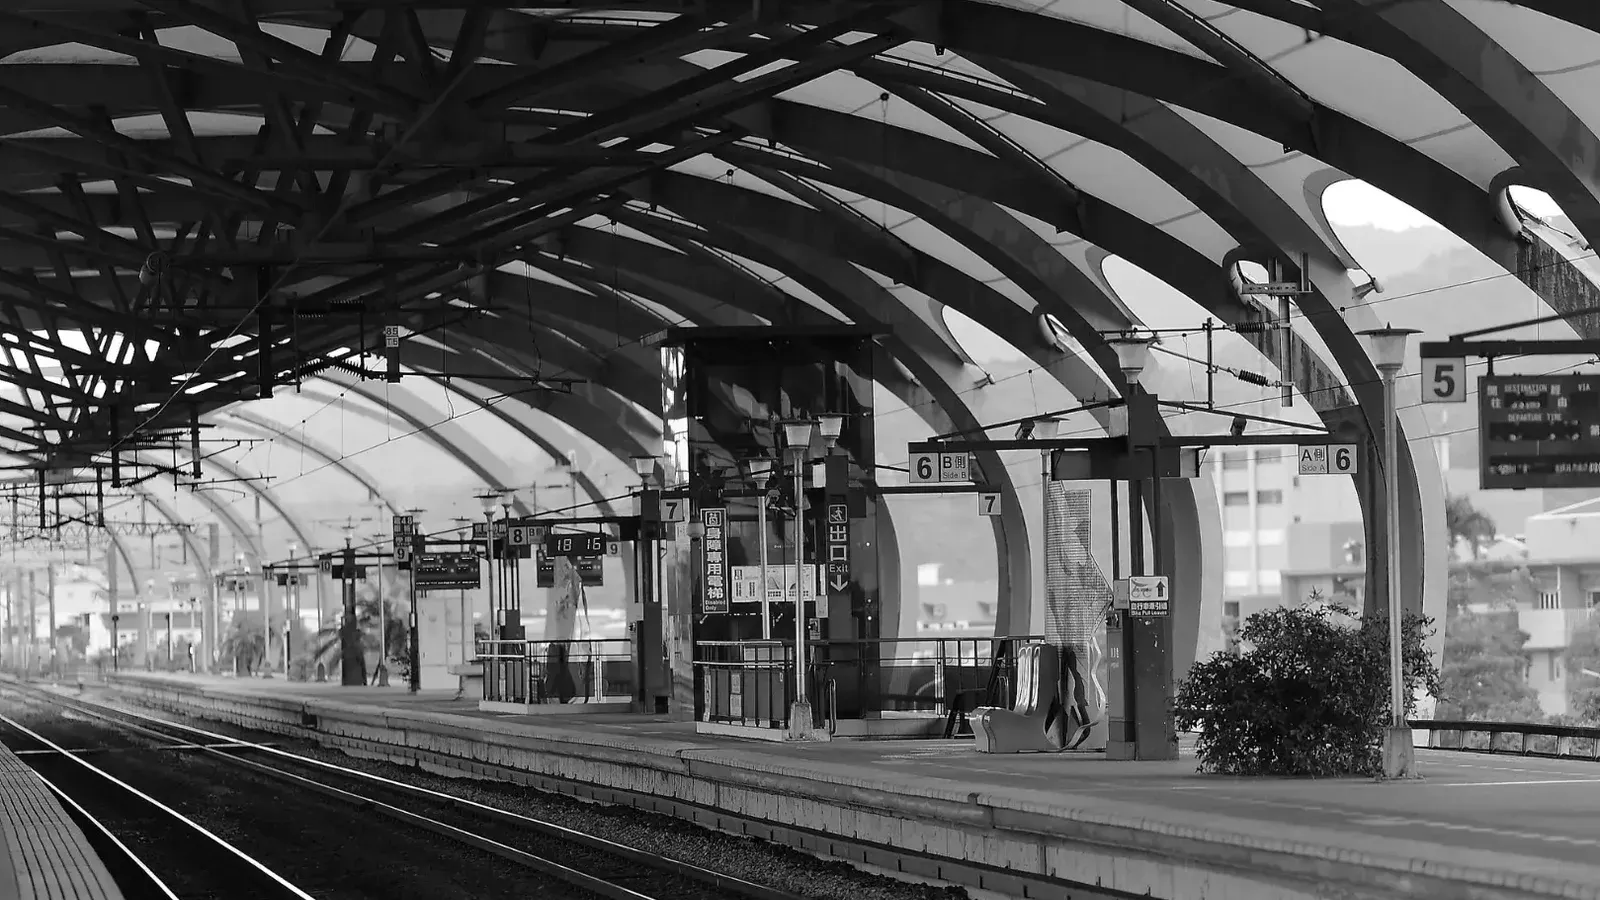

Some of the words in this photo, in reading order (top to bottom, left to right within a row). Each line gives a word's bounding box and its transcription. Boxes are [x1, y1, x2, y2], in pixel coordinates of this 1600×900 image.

[1433, 364, 1455, 397] 5
[1578, 383, 1591, 391] VIA
[1336, 448, 1350, 470] 6
[917, 457, 932, 479] 6
[666, 502, 677, 519] 7
[984, 496, 995, 512] 7
[513, 528, 522, 543] 8
[829, 525, 847, 561] 出口
[397, 548, 404, 559] 9
[610, 543, 618, 554] 9
[829, 563, 848, 573] Exit
